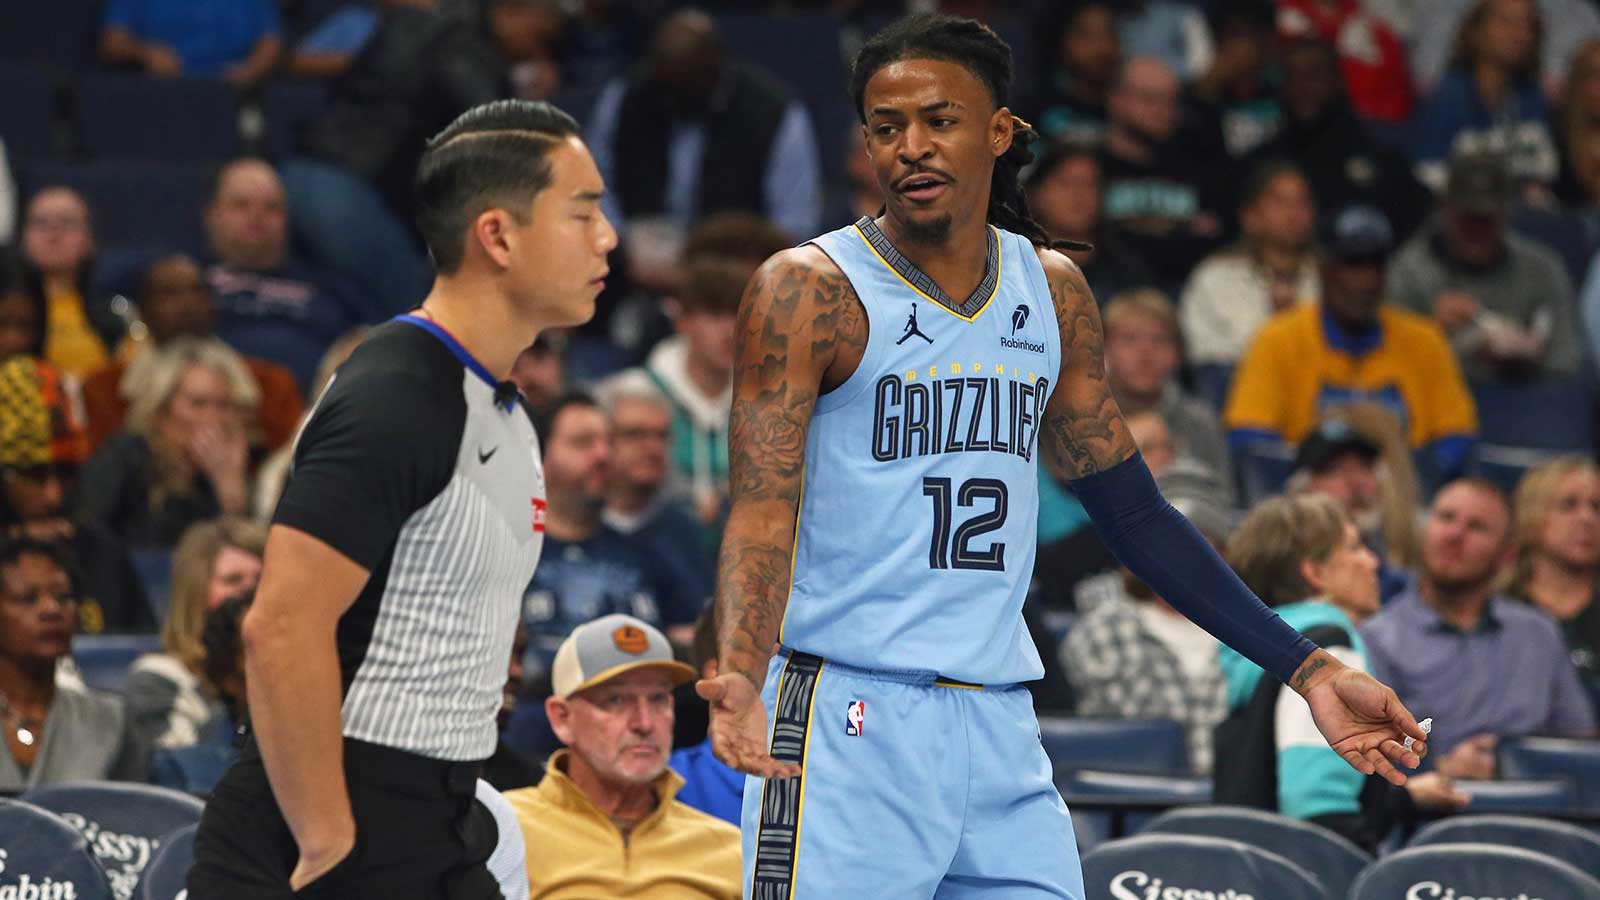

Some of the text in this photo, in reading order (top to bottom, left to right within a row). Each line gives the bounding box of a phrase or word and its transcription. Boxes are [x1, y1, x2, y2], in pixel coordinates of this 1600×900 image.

[1001, 337, 1045, 353] Robinhood
[905, 363, 1035, 384] MEMPHIS
[872, 374, 1049, 463] GRIZZLIES
[923, 477, 1008, 572] 12
[0, 873, 77, 900] abin
